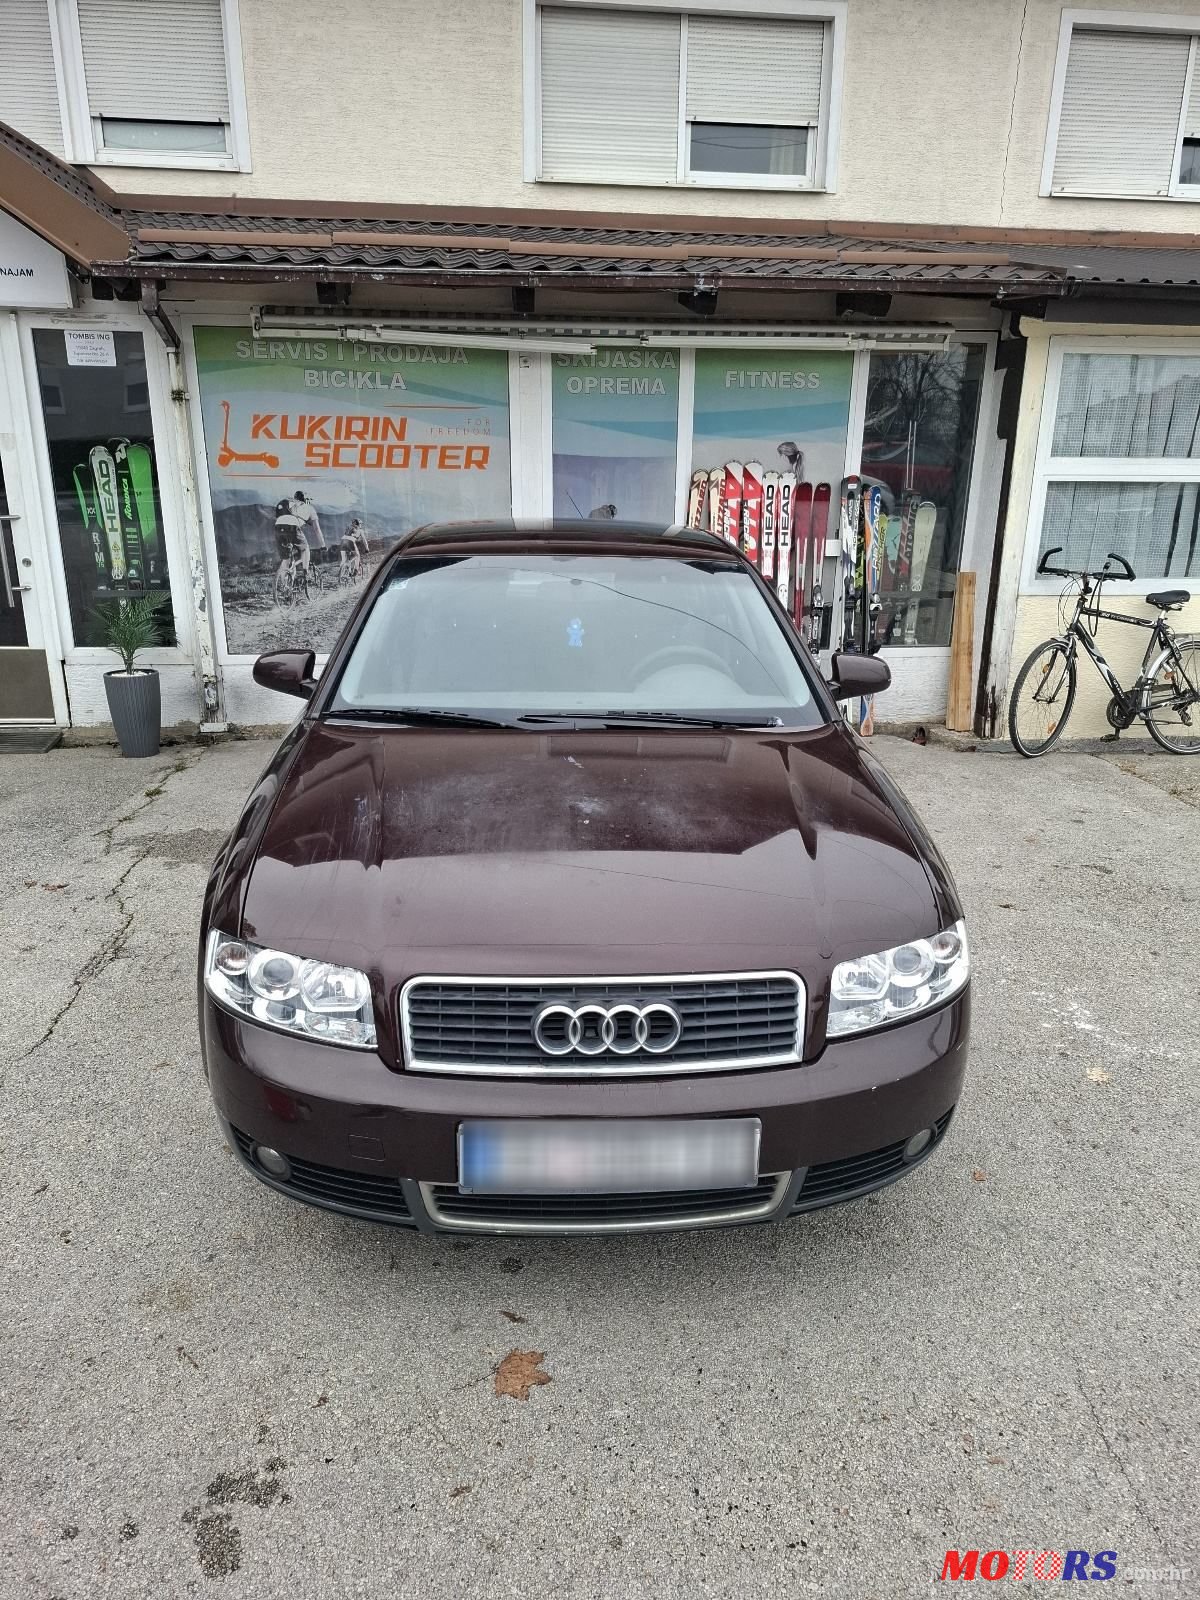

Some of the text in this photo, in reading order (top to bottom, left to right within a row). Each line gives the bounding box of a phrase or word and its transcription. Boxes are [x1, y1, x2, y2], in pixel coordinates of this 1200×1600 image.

[0, 268, 34, 277] NAJAM
[236, 340, 469, 364] SERVIS I PRODAJA
[304, 369, 407, 390] BICIKLA
[566, 376, 666, 395] OPREMA
[725, 370, 820, 390] FITNESS
[251, 414, 408, 441] KUKIRIN
[429, 428, 492, 436] FREEDOM
[304, 443, 490, 470] SCOOTER
[98, 460, 118, 533] HEAD
[123, 478, 133, 520] NORDICA
[716, 478, 726, 534] LIZZARD
[764, 485, 774, 547] HEAD
[781, 485, 790, 547] HEAD
